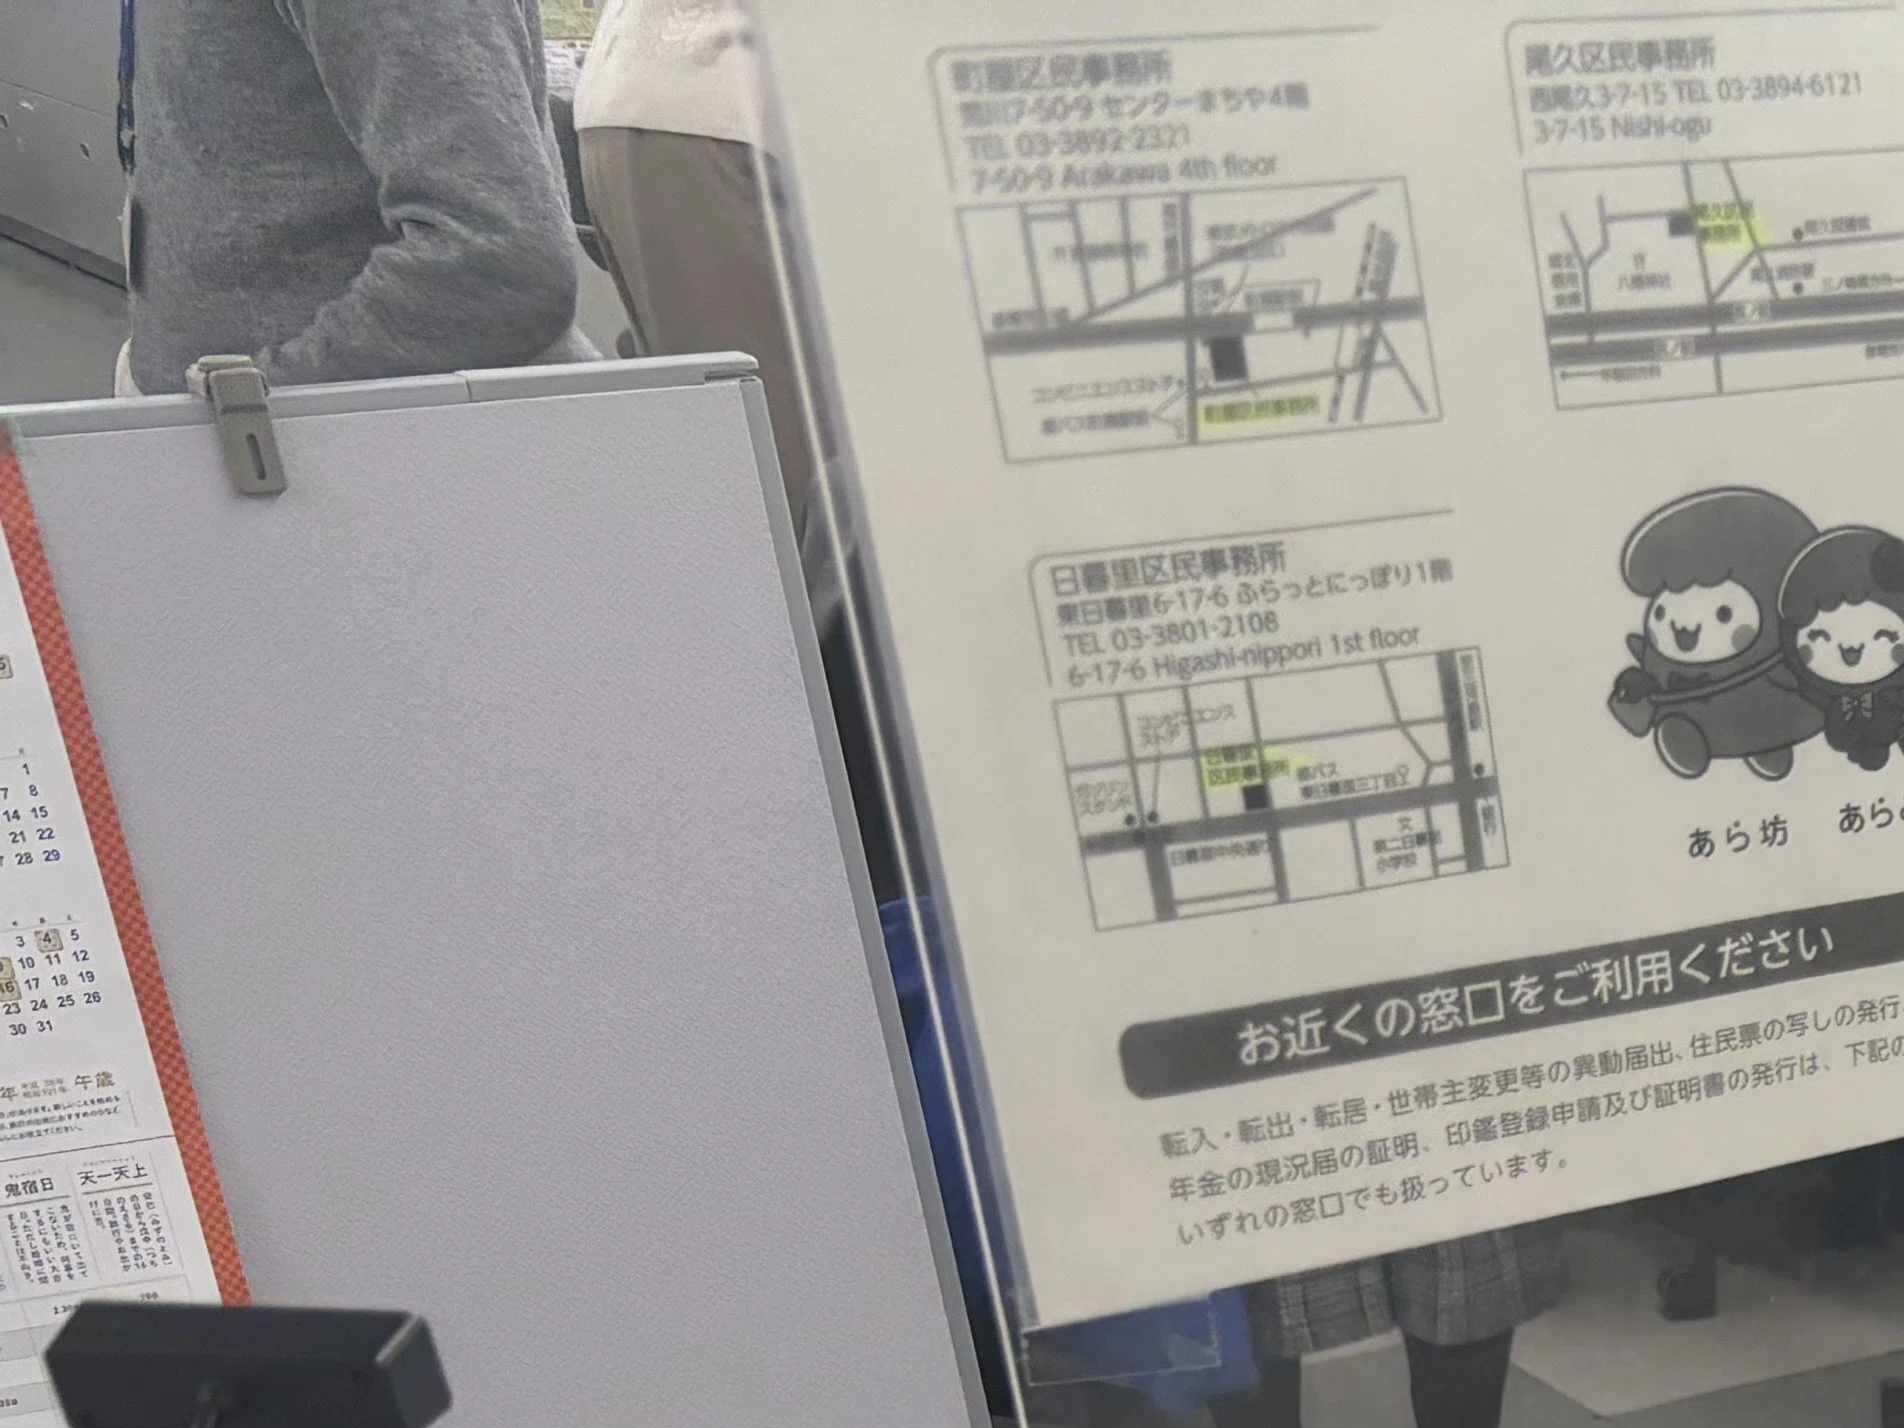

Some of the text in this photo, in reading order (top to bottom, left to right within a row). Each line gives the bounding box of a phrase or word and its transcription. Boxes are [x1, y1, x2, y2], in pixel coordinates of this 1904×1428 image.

[1673, 77, 1711, 105] TEL
[1717, 73, 1864, 103] 03-3894-6121
[1533, 112, 1713, 142] 3-7-15 Nishi-ogu
[967, 134, 1010, 161] TEL
[971, 154, 1278, 194] 7-50-9 Arakawa 4th floor
[1049, 541, 1288, 597] 日暮里区民事務所
[1062, 611, 1280, 658] TEL 03-3801-2108
[1067, 622, 1421, 687] 6-17-6 Higashi-nippori 1st floor
[28, 784, 39, 797] 8
[3, 806, 49, 822] 14 15
[9, 828, 55, 844] 21 22
[1686, 816, 1791, 862] あら坊
[14, 849, 61, 866] 28 29
[15, 929, 80, 948] 3 4 5
[17, 949, 90, 970] 10 11 12
[24, 977, 41, 991] 17
[51, 973, 69, 987] 18
[78, 970, 96, 984] 19
[2, 991, 102, 1017] 23 24 25 26
[1237, 923, 1835, 1068] お近くの窓口をご利用ください
[9, 1019, 54, 1036] 30 31
[77, 1163, 149, 1187] 天一天上
[1176, 1153, 1571, 1249] いずれの窓口でも扱っています。
